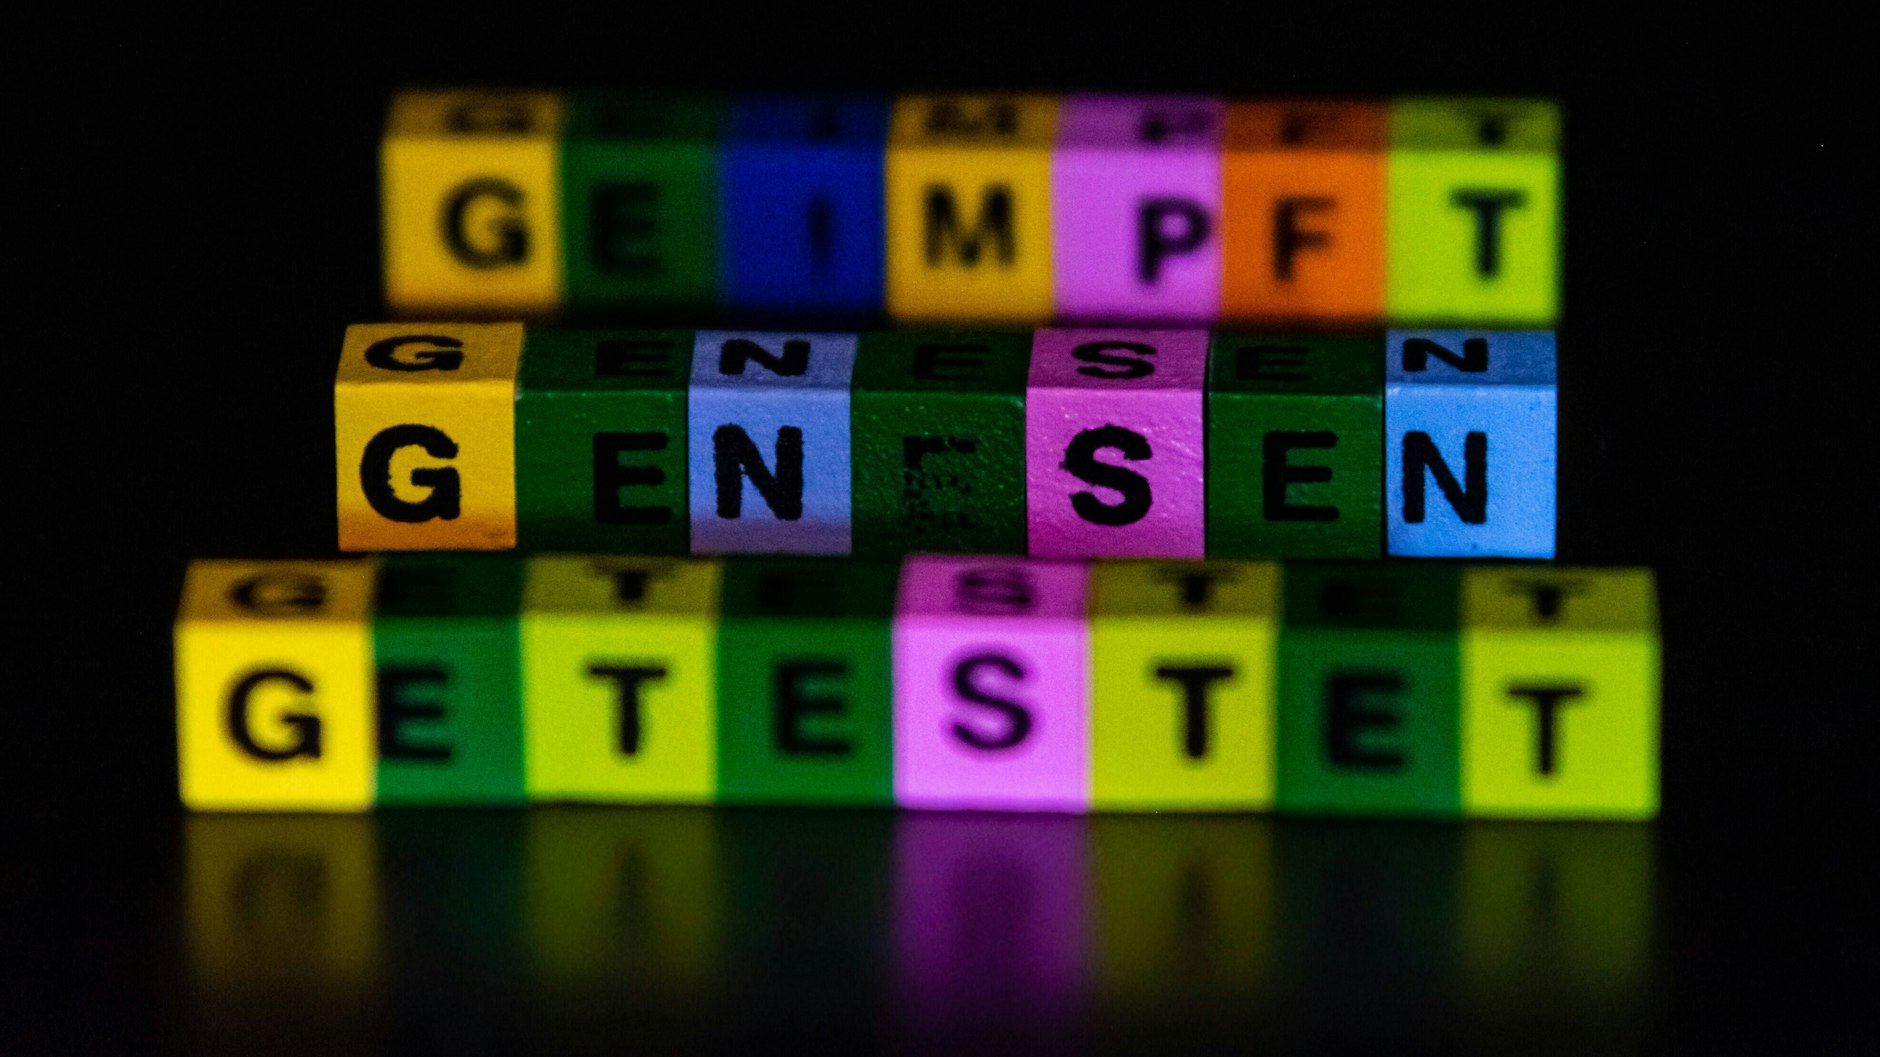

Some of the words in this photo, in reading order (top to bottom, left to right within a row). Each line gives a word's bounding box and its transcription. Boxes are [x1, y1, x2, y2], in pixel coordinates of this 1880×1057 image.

[441, 179, 1527, 283] GEIMPFT
[364, 334, 1489, 379] GENESEN
[228, 654, 1584, 776] GETESTET
